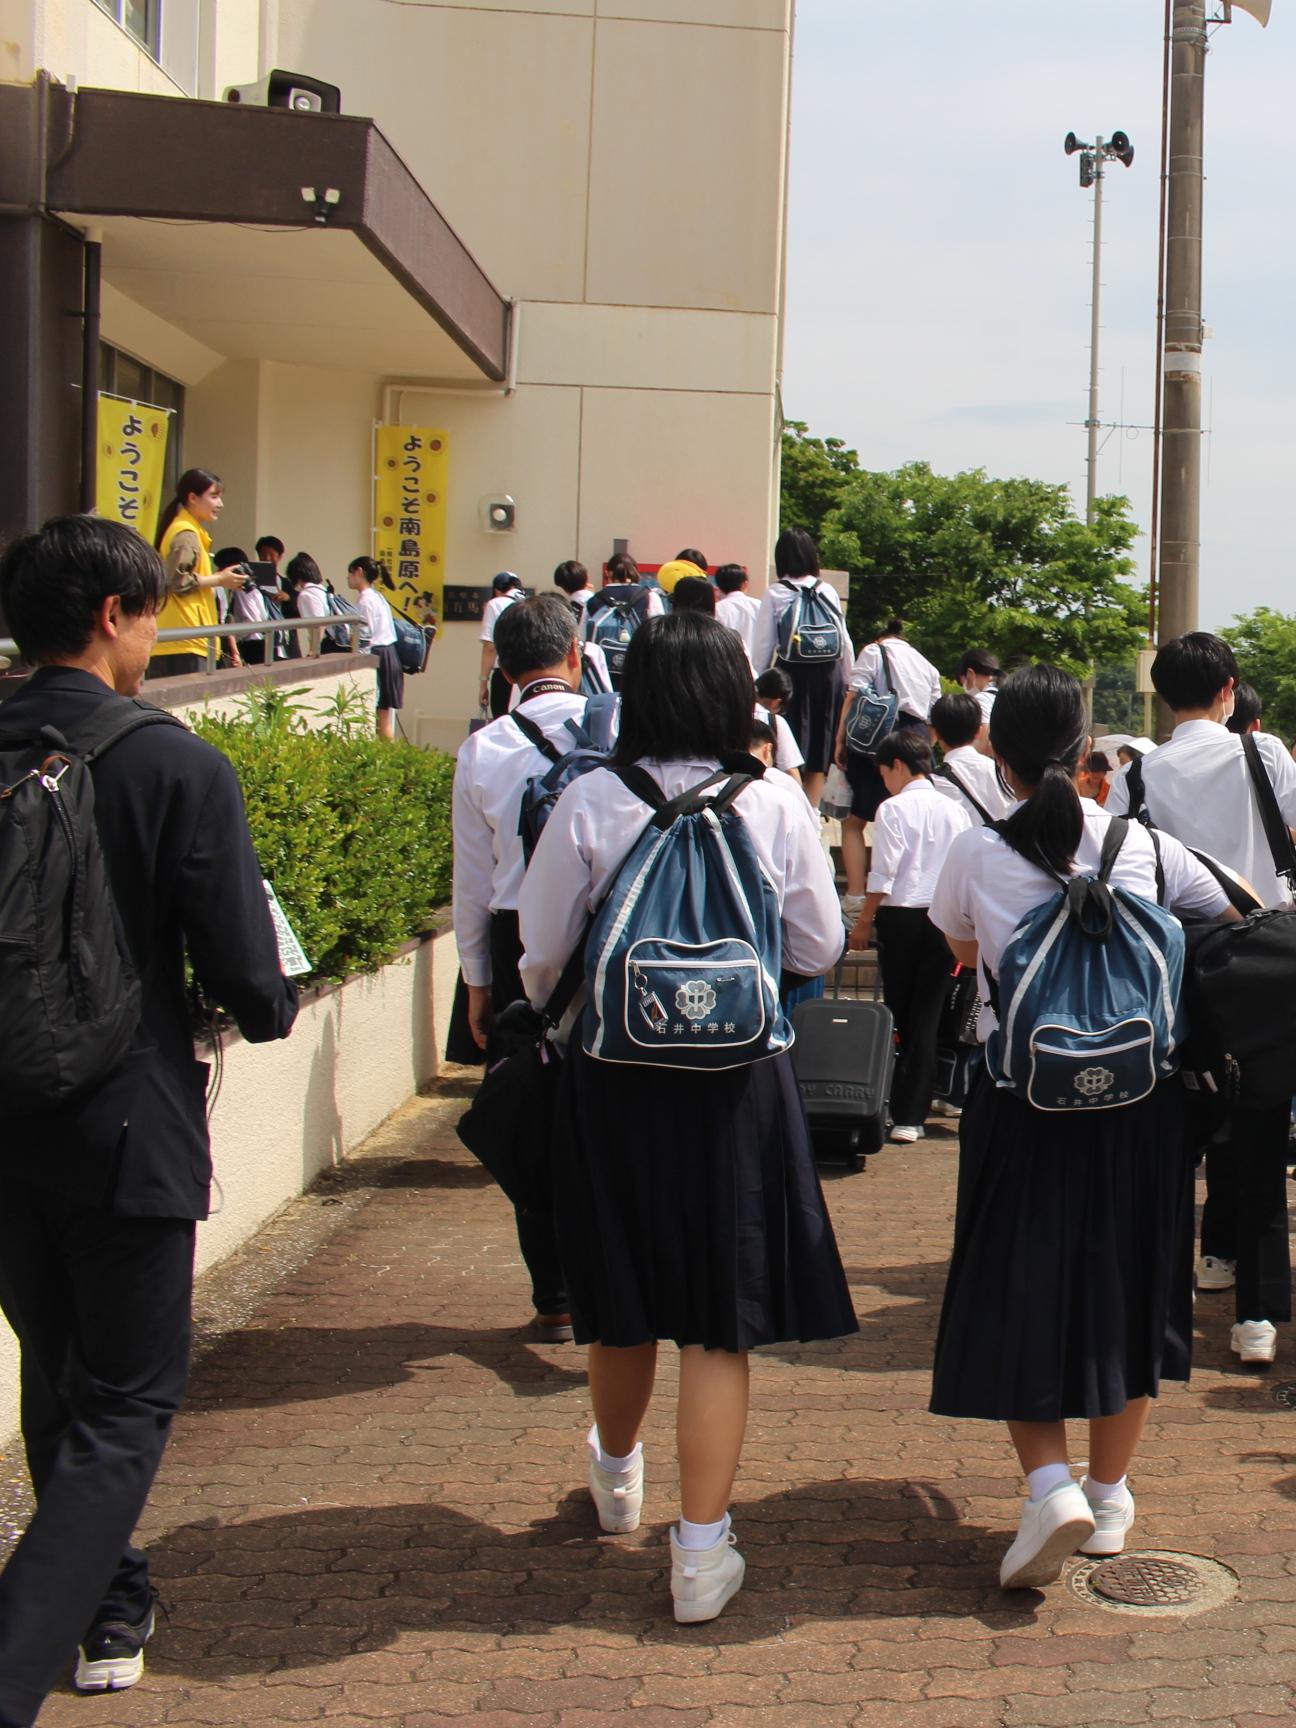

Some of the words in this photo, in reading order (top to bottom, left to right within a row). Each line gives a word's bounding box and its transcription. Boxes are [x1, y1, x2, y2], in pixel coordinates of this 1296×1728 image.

[119, 414, 143, 520] ようこそ
[533, 684, 566, 693] Canon
[655, 1021, 736, 1034] 石井中学校
